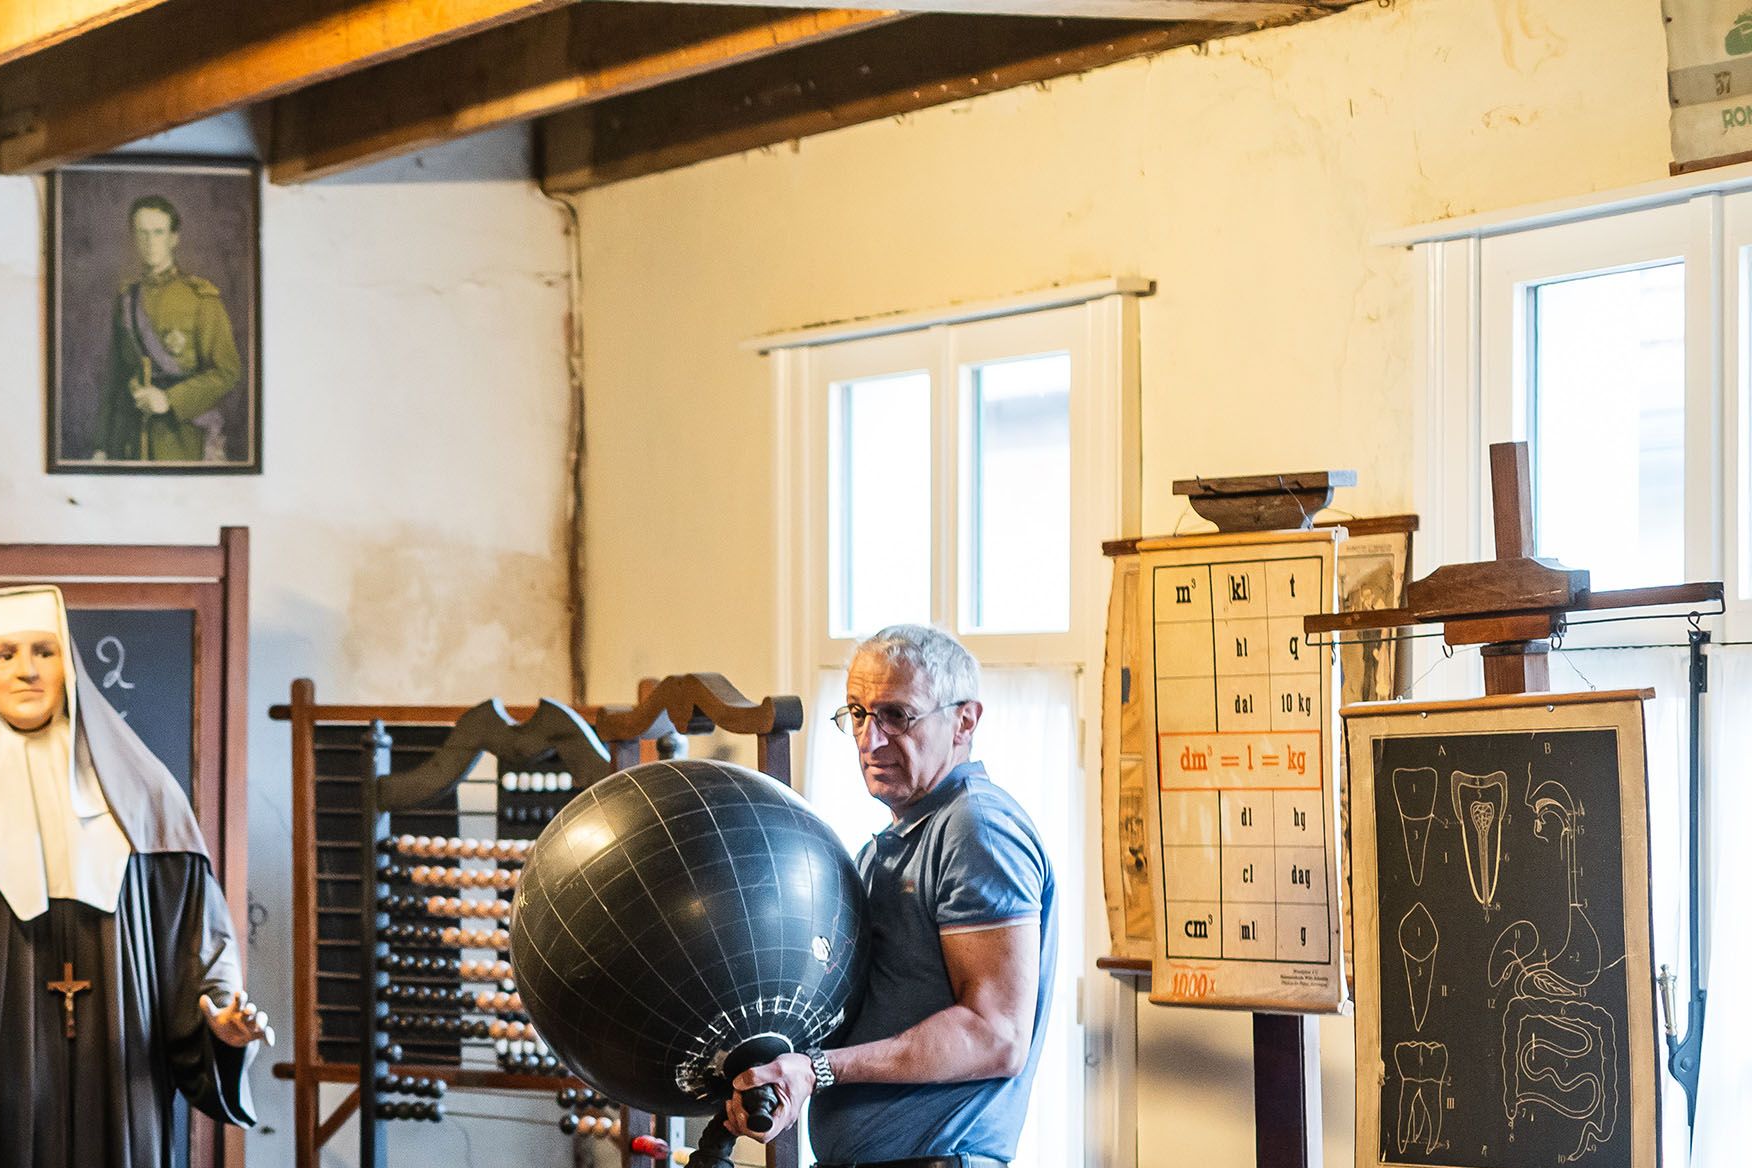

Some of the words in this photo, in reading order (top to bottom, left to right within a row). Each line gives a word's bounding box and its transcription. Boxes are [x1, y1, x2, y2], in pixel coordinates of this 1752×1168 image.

[1289, 573, 1296, 598] t
[1236, 637, 1248, 657] hl
[1289, 636, 1299, 660] q
[96, 636, 136, 689] 2
[1235, 695, 1253, 714] dal
[1281, 694, 1293, 713] 10
[1298, 693, 1311, 716] kg
[1438, 744, 1446, 757] A
[1544, 742, 1552, 754] B
[1287, 745, 1307, 774] kg
[1241, 807, 1253, 827] dl
[1293, 807, 1306, 831] hg
[1242, 864, 1254, 884] cl
[1291, 864, 1311, 889] dag
[1300, 926, 1307, 946] g
